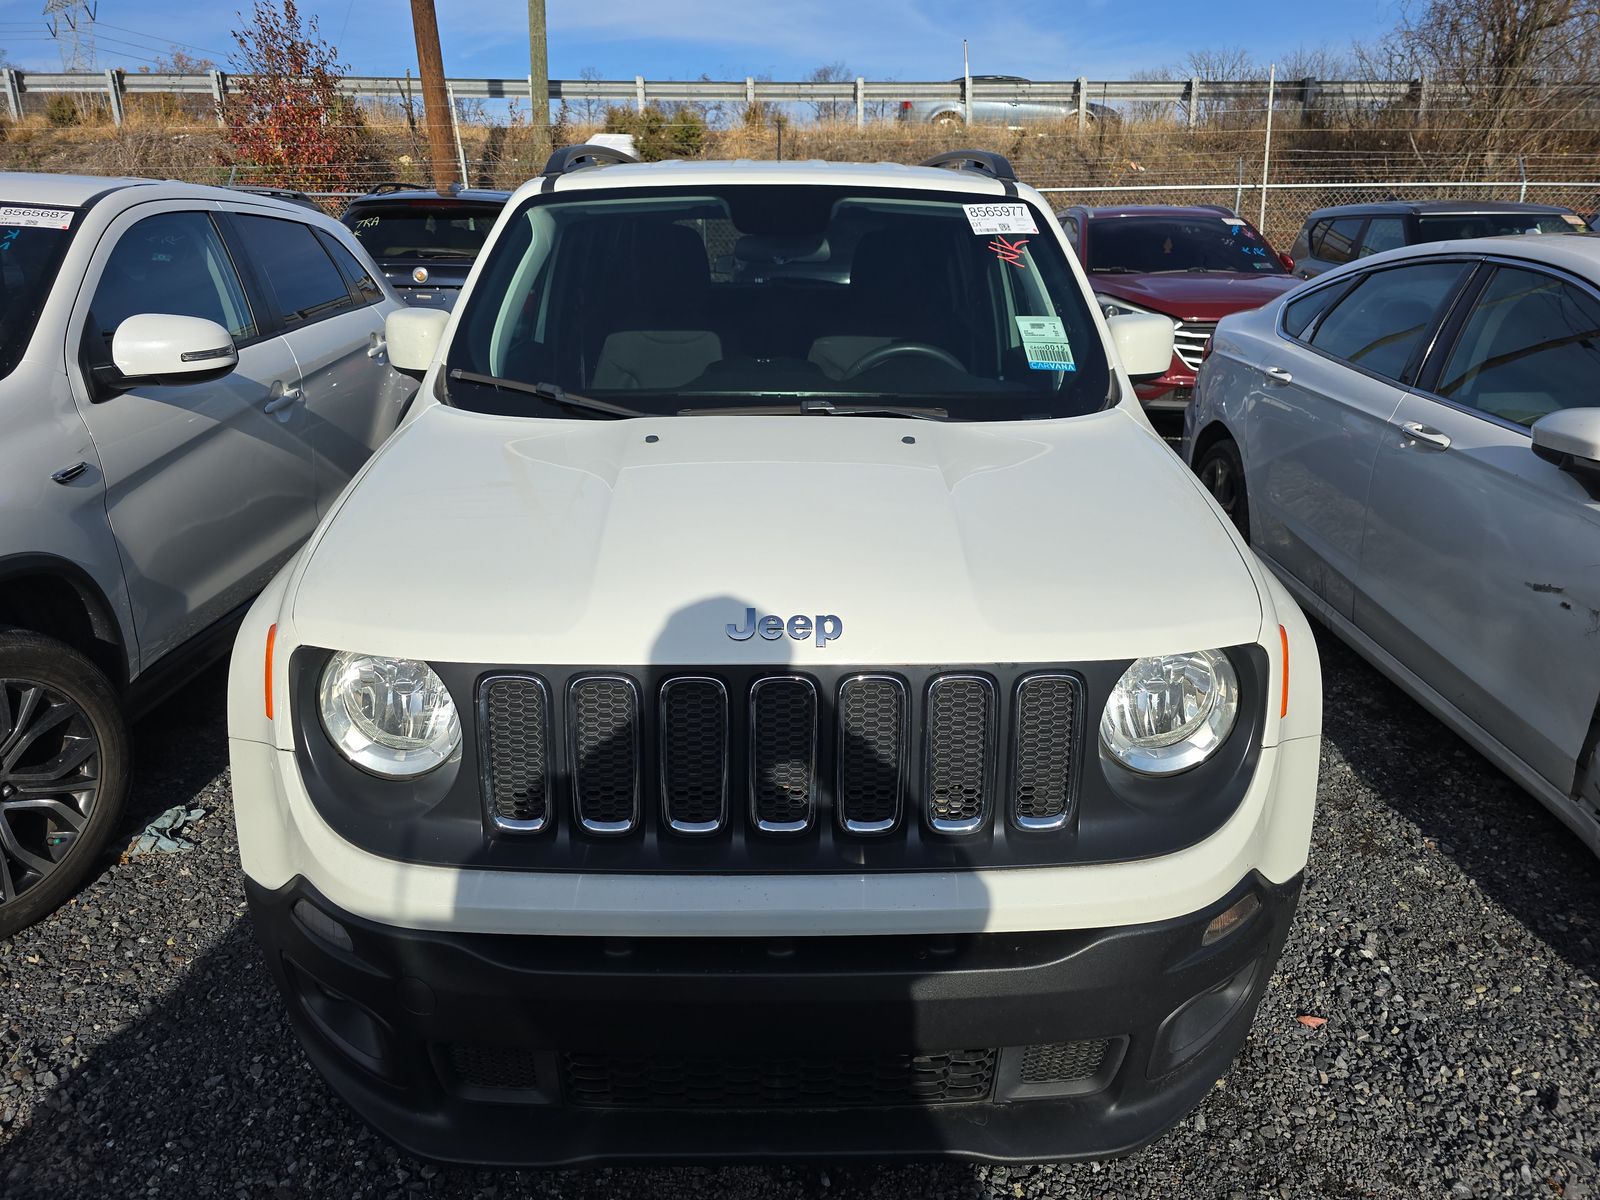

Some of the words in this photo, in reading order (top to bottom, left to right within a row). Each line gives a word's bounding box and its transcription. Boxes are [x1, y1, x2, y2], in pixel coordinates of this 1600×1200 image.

[3, 209, 69, 219] 8565687
[968, 206, 1024, 217] 8565977
[1031, 362, 1076, 371] CARVANA
[725, 607, 843, 648] Jeep
